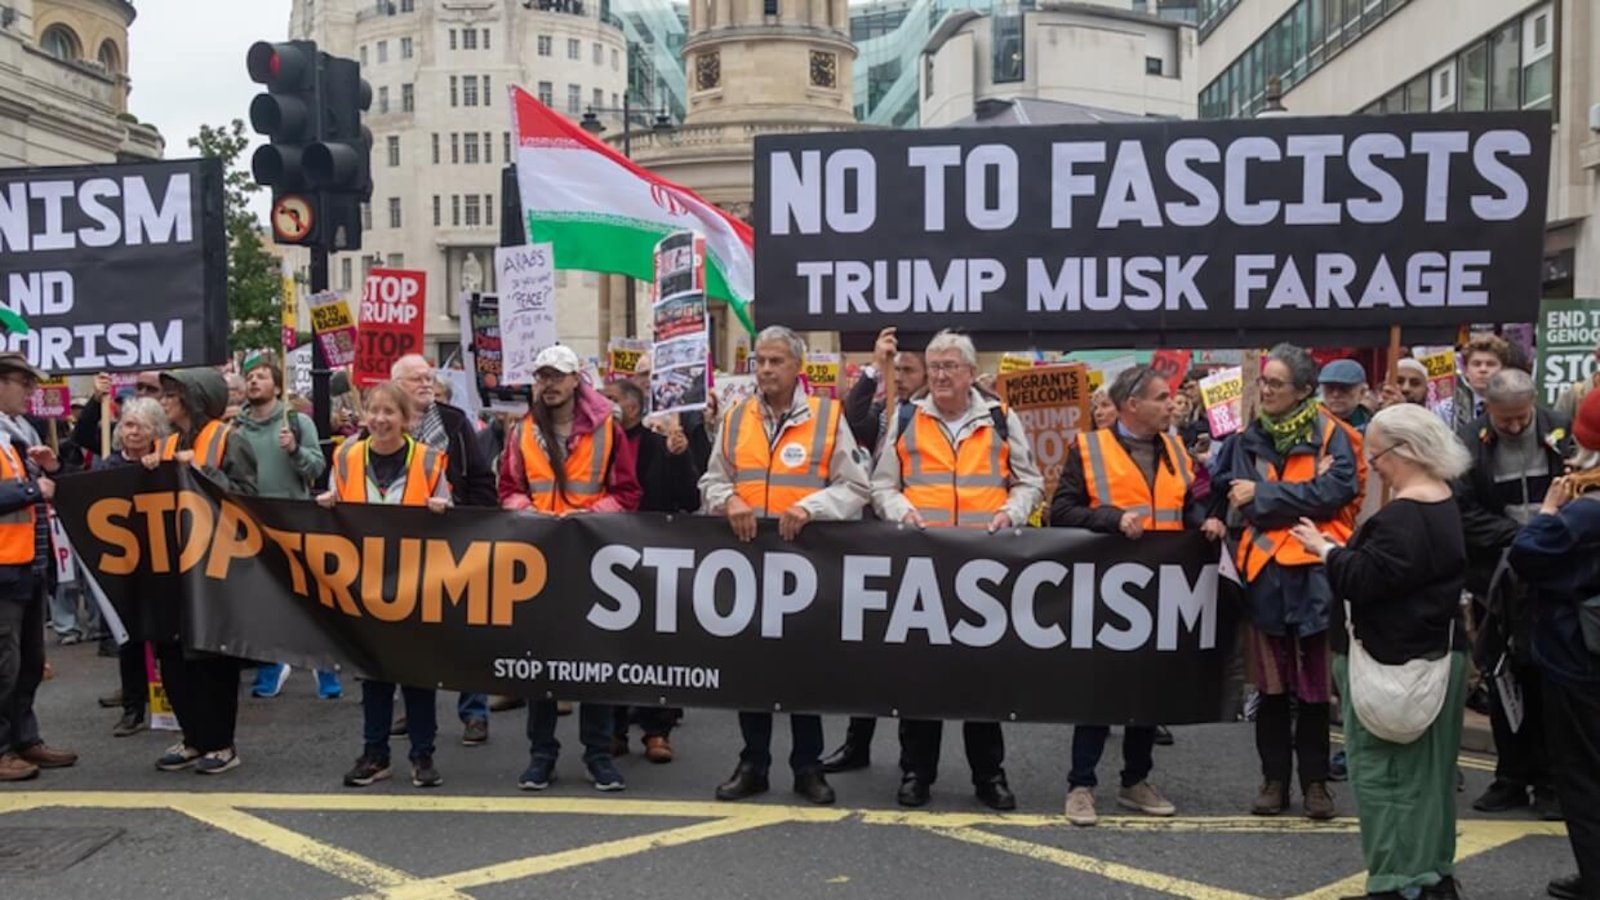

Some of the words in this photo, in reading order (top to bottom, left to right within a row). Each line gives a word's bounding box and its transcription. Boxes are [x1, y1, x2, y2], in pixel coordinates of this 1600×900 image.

[771, 149, 877, 235] NO
[908, 145, 1019, 231] TO
[1051, 129, 1531, 229] FASCISTS
[797, 258, 1006, 314] TRUMP
[1027, 255, 1208, 311] MUSK
[1235, 251, 1491, 309] FARAGE
[360, 302, 417, 324] RUMP
[1547, 310, 1586, 329] END
[1007, 370, 1079, 392] MIGRANTS
[1008, 386, 1079, 408] WELCOME
[1020, 406, 1081, 433] RUMP
[86, 490, 263, 579] STOP
[262, 524, 547, 627] TRUMP
[586, 544, 818, 638] STOP
[841, 555, 1219, 651] FASCISM
[494, 658, 543, 679] STOP
[547, 660, 613, 683] TRUMP
[617, 663, 719, 688] COALITION
